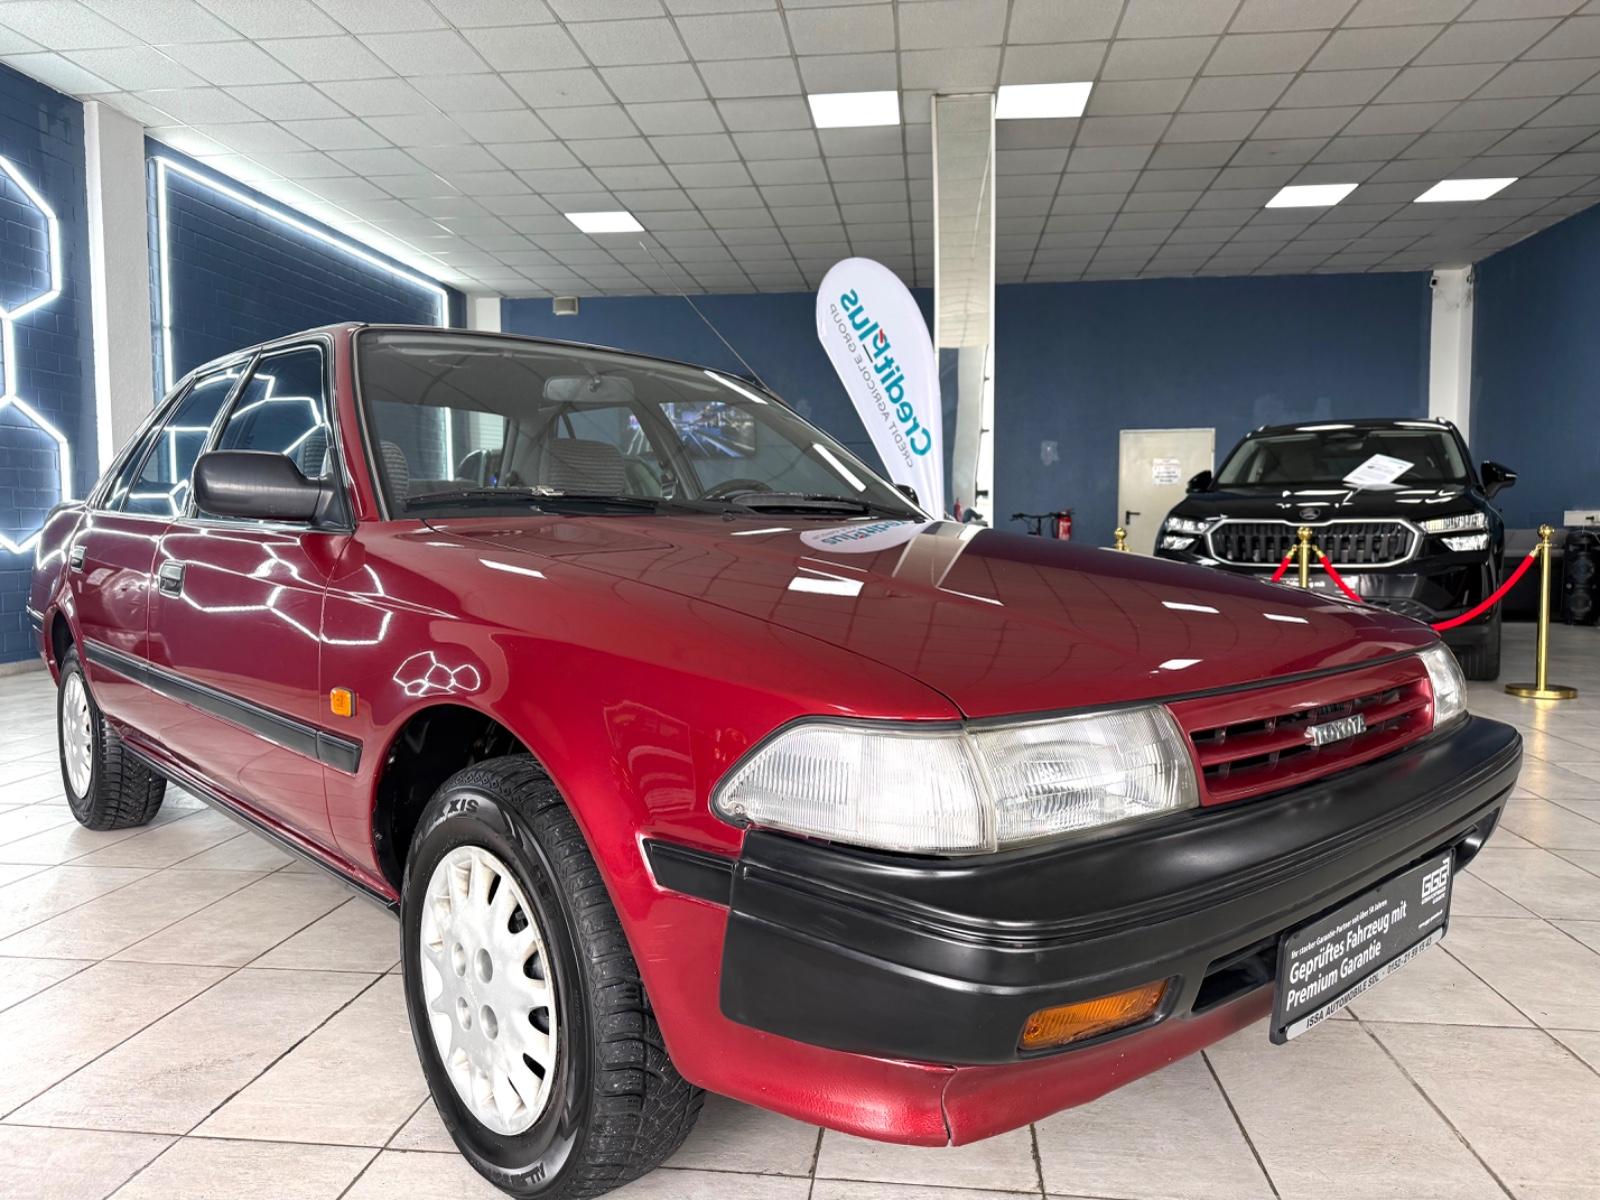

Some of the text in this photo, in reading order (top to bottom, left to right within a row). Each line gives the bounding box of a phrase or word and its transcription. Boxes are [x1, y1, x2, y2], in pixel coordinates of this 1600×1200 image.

[1311, 713, 1367, 746] TOYOTA
[1421, 864, 1448, 899] GGG
[1289, 941, 1345, 985] Geprüftes
[1345, 917, 1390, 953] Fahrzeug
[1390, 900, 1408, 924] mit
[1286, 940, 1381, 1012] Premium Garantie
[1306, 1010, 1324, 1029] ISSA
[1325, 981, 1367, 1017] AUTOMOBILE
